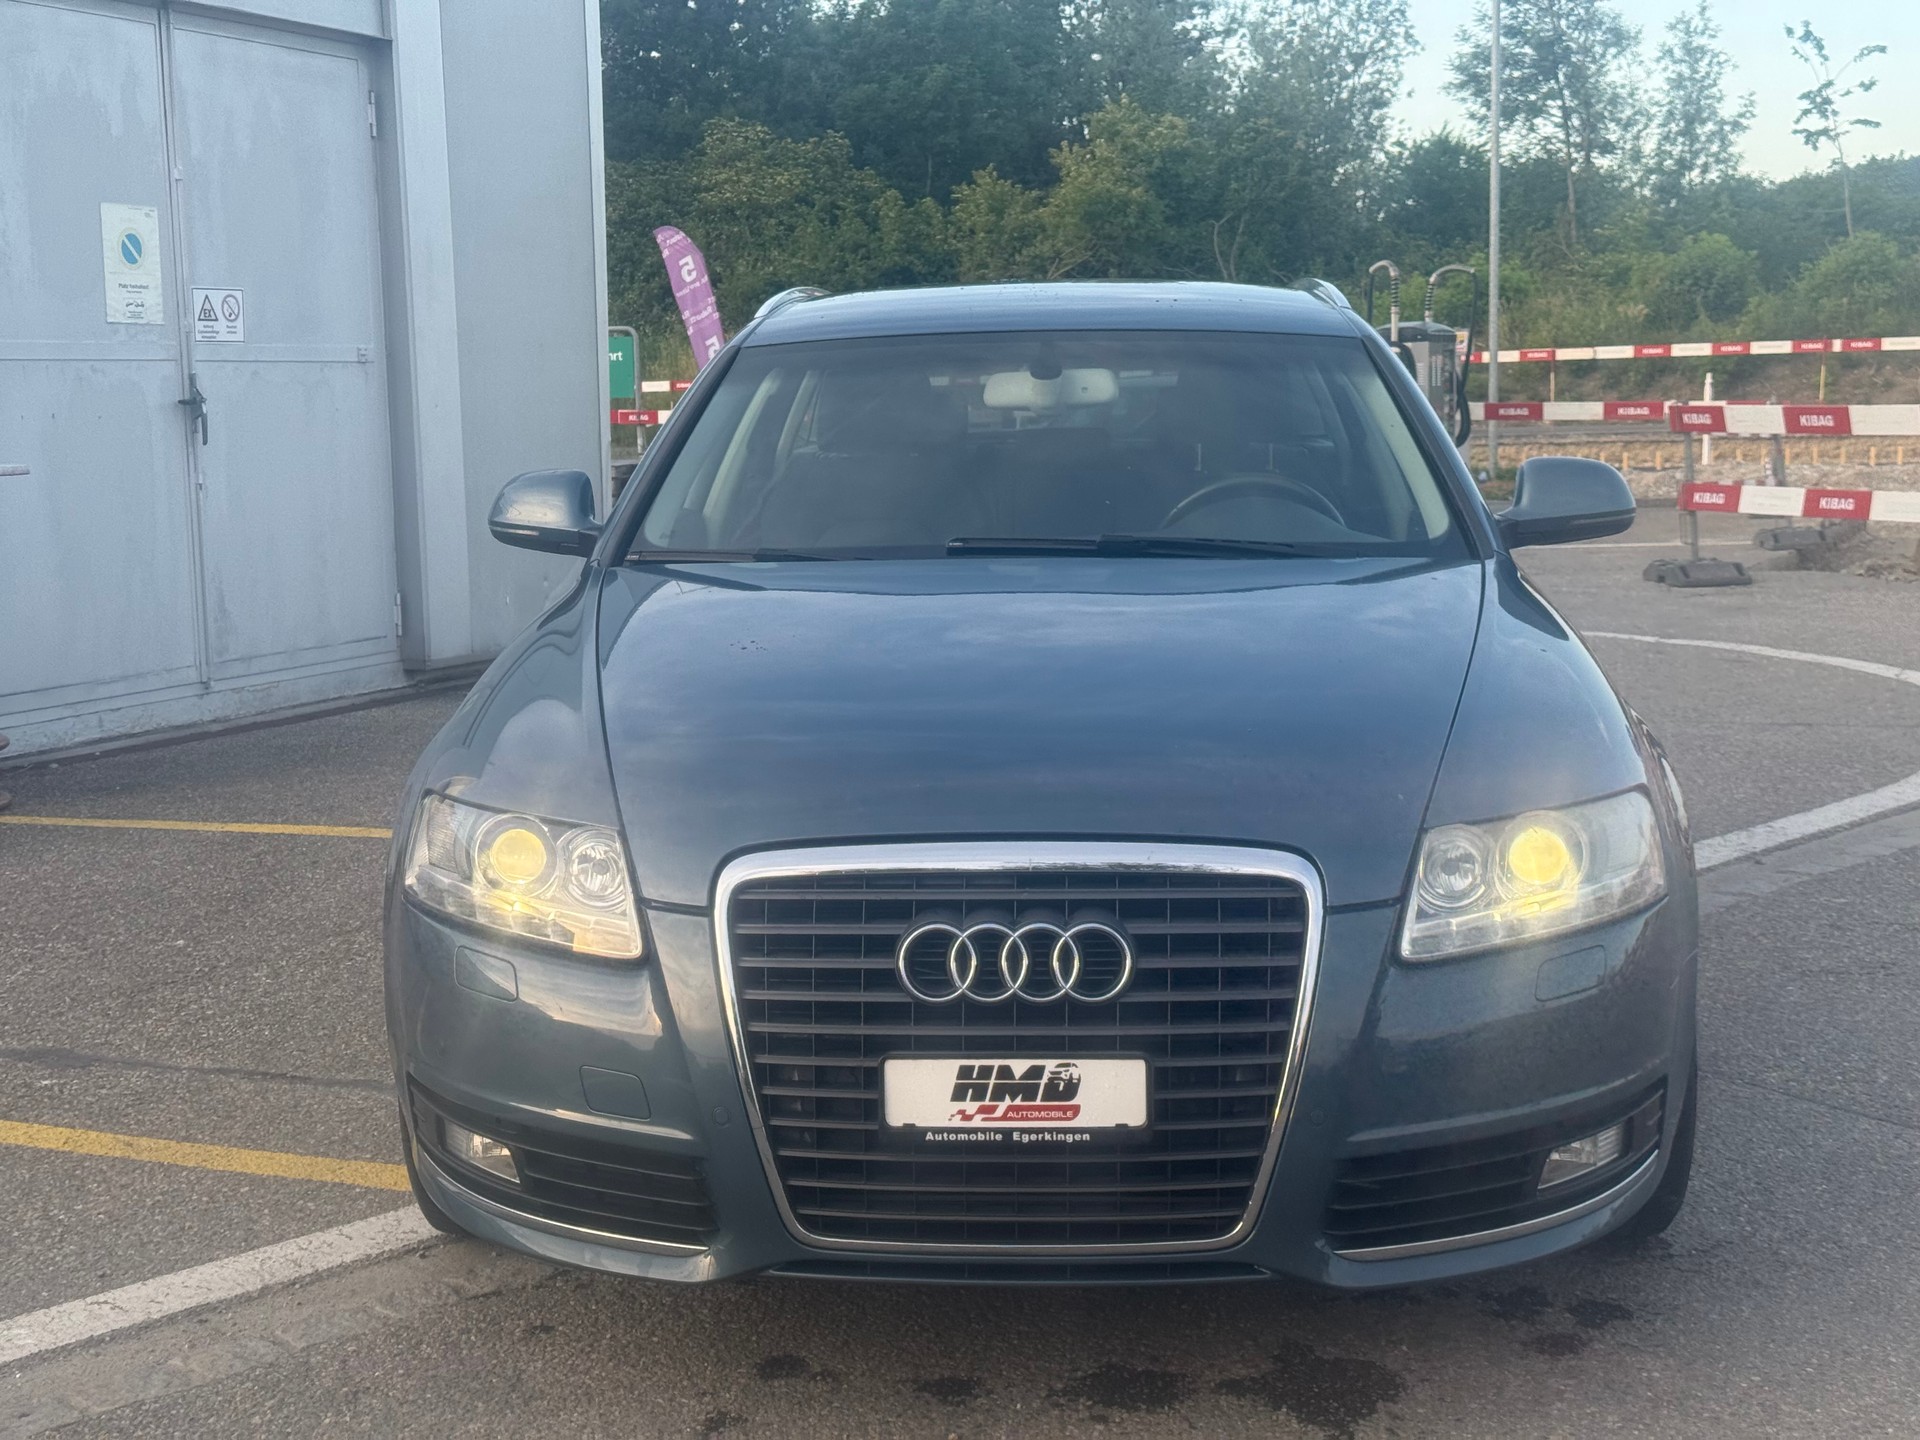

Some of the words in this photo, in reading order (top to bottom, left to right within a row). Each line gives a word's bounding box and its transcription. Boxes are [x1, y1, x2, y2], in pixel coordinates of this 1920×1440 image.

[203, 308, 213, 319] EX
[1682, 413, 1713, 425] KIBAG
[1799, 414, 1834, 427] KIBAG
[1692, 492, 1726, 504] KIBAG
[1818, 497, 1855, 510] KIBAG
[1006, 1110, 1074, 1119] AUTOMOBILE
[925, 1130, 1003, 1142] Automobile
[1012, 1130, 1091, 1144] Egerkingen
